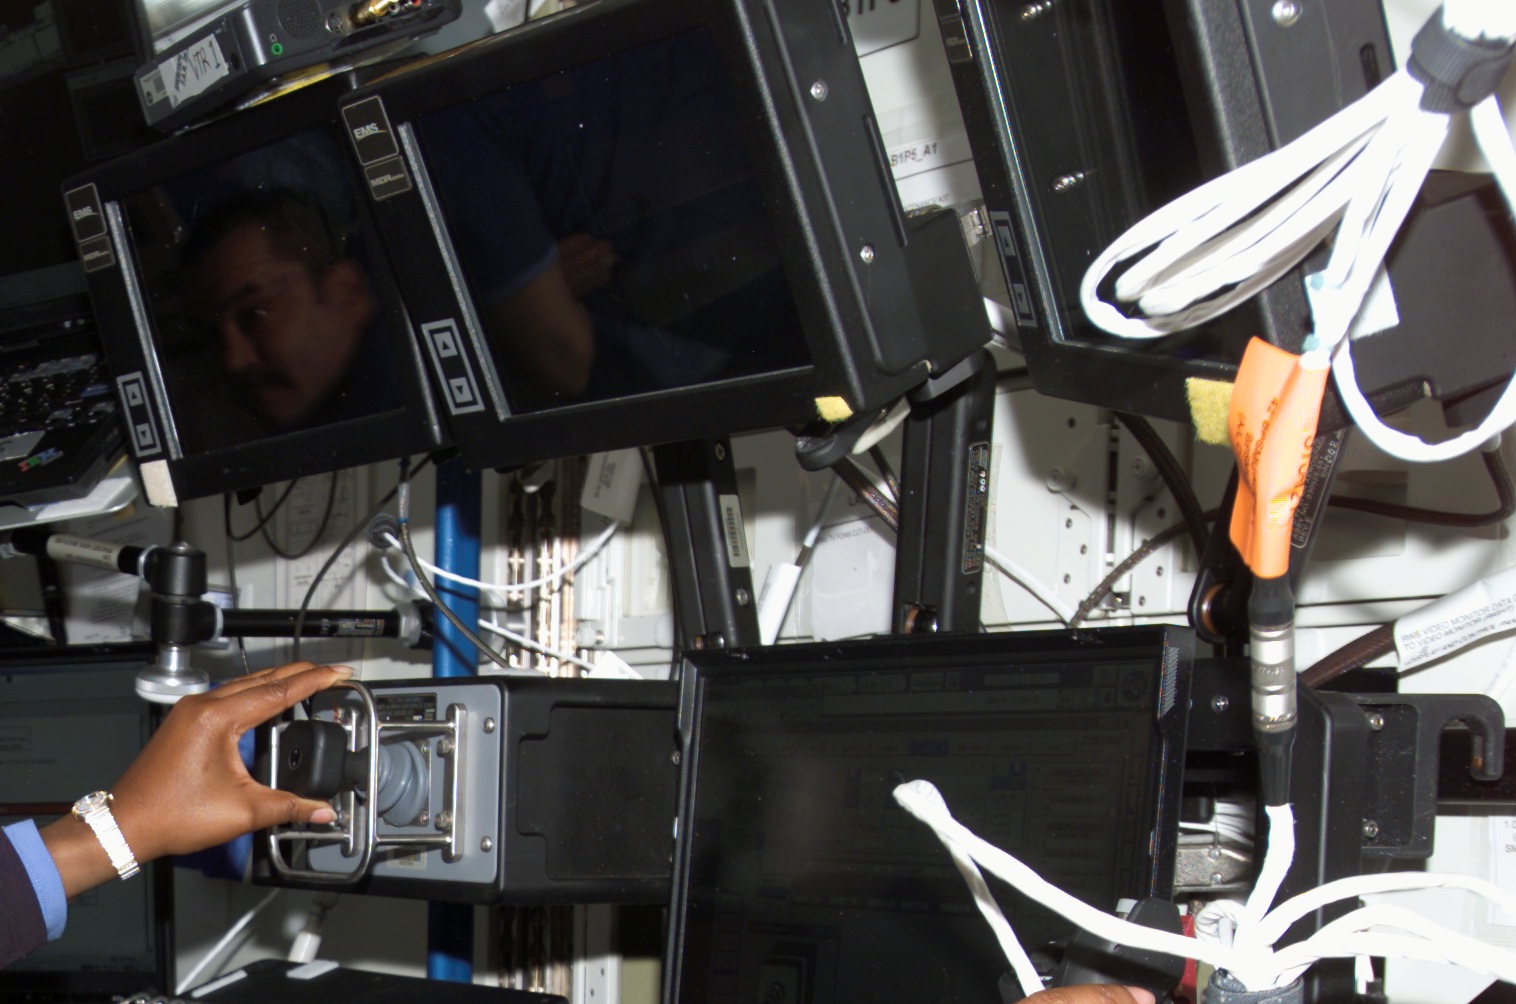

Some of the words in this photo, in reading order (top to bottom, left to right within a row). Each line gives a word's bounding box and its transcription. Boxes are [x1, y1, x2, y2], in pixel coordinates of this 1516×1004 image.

[187, 46, 214, 80] VTR
[353, 123, 379, 140] EMS
[72, 206, 93, 220] EMS
[1421, 619, 1450, 637] VIDEO
[1449, 604, 1490, 626] MONITOR
[1490, 596, 1513, 610] DATA
[1403, 640, 1416, 651] TO
[1417, 630, 1443, 646] VIDEO
